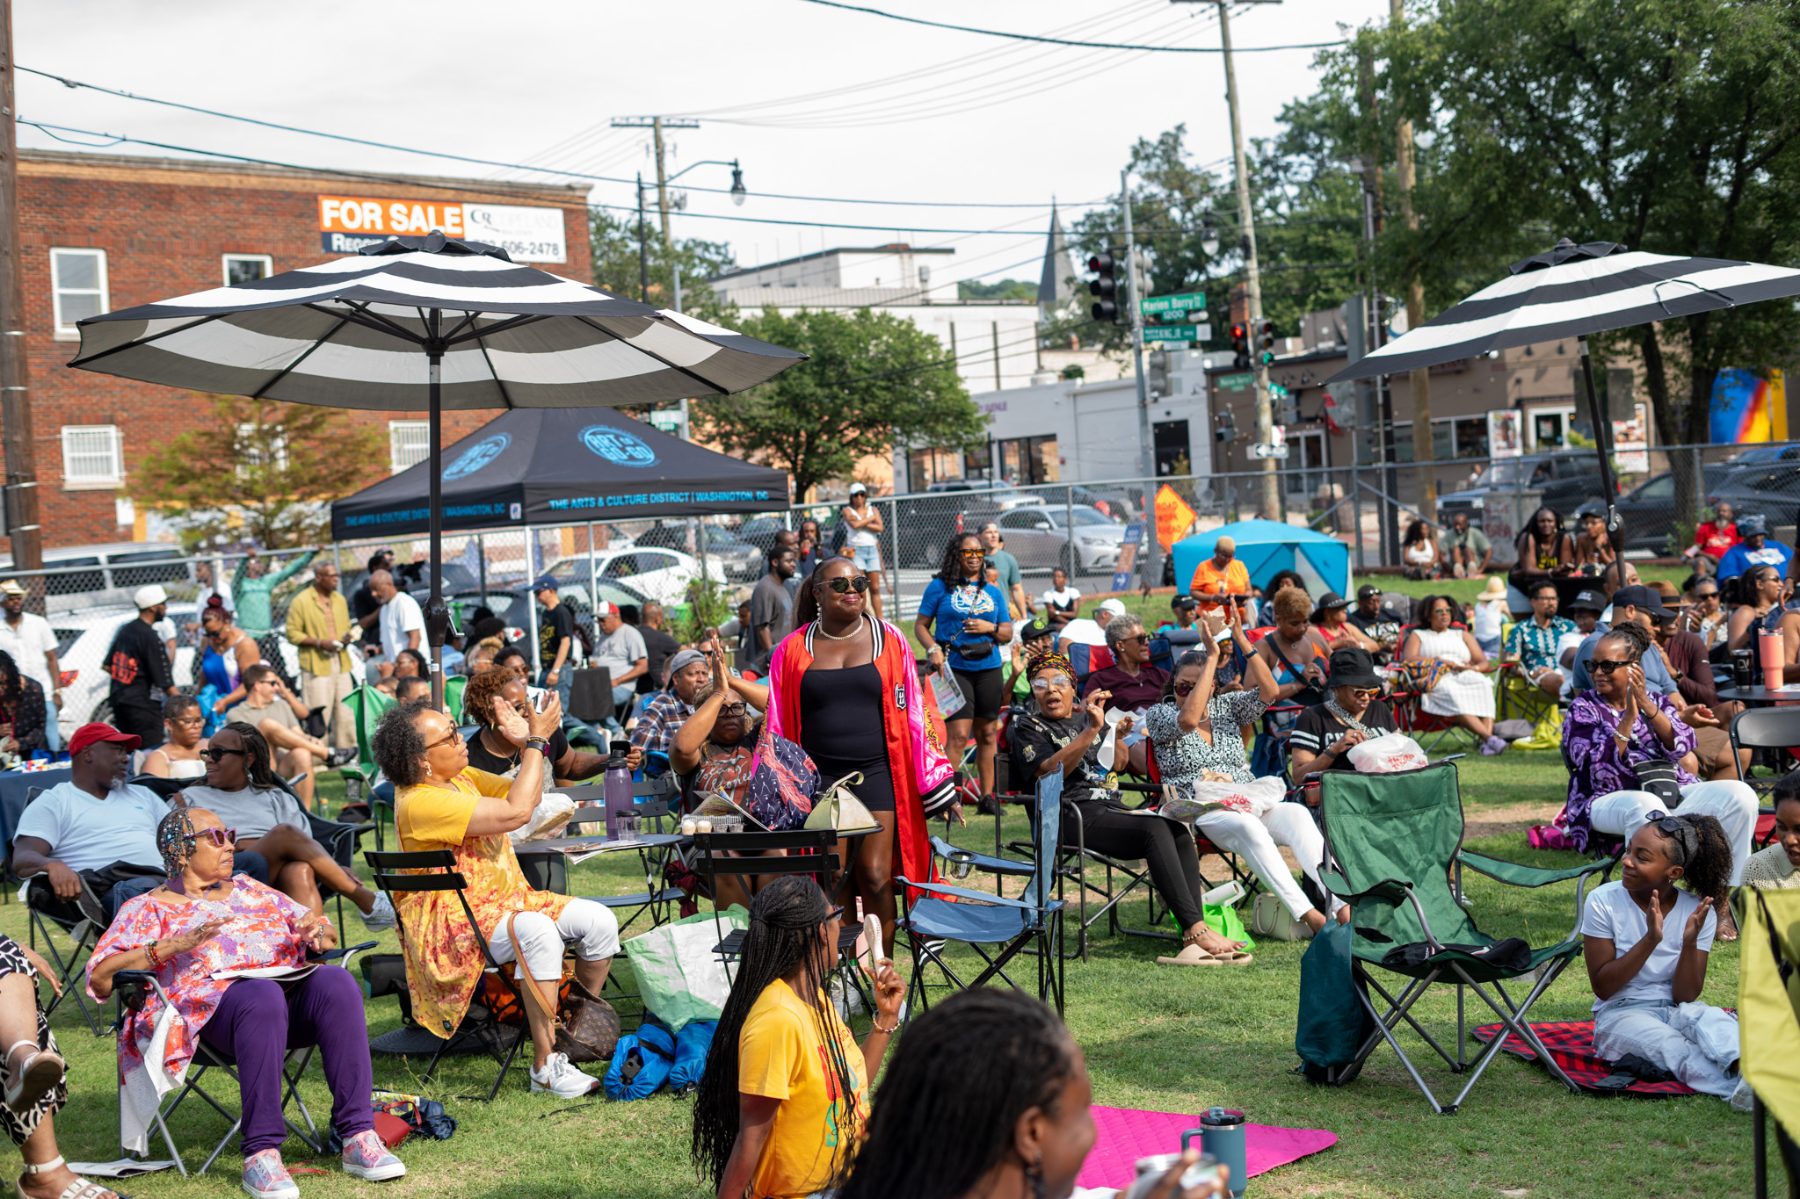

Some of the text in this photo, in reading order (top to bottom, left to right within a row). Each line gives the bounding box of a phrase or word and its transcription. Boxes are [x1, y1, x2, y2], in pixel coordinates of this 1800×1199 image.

[321, 199, 384, 231] FOR
[389, 202, 463, 235] SALE
[549, 500, 569, 511] THE
[570, 497, 596, 509] ARTS
[598, 496, 605, 507] &
[606, 494, 648, 507] CULTURE
[649, 492, 689, 505] DISTRICT
[756, 490, 769, 501] DC
